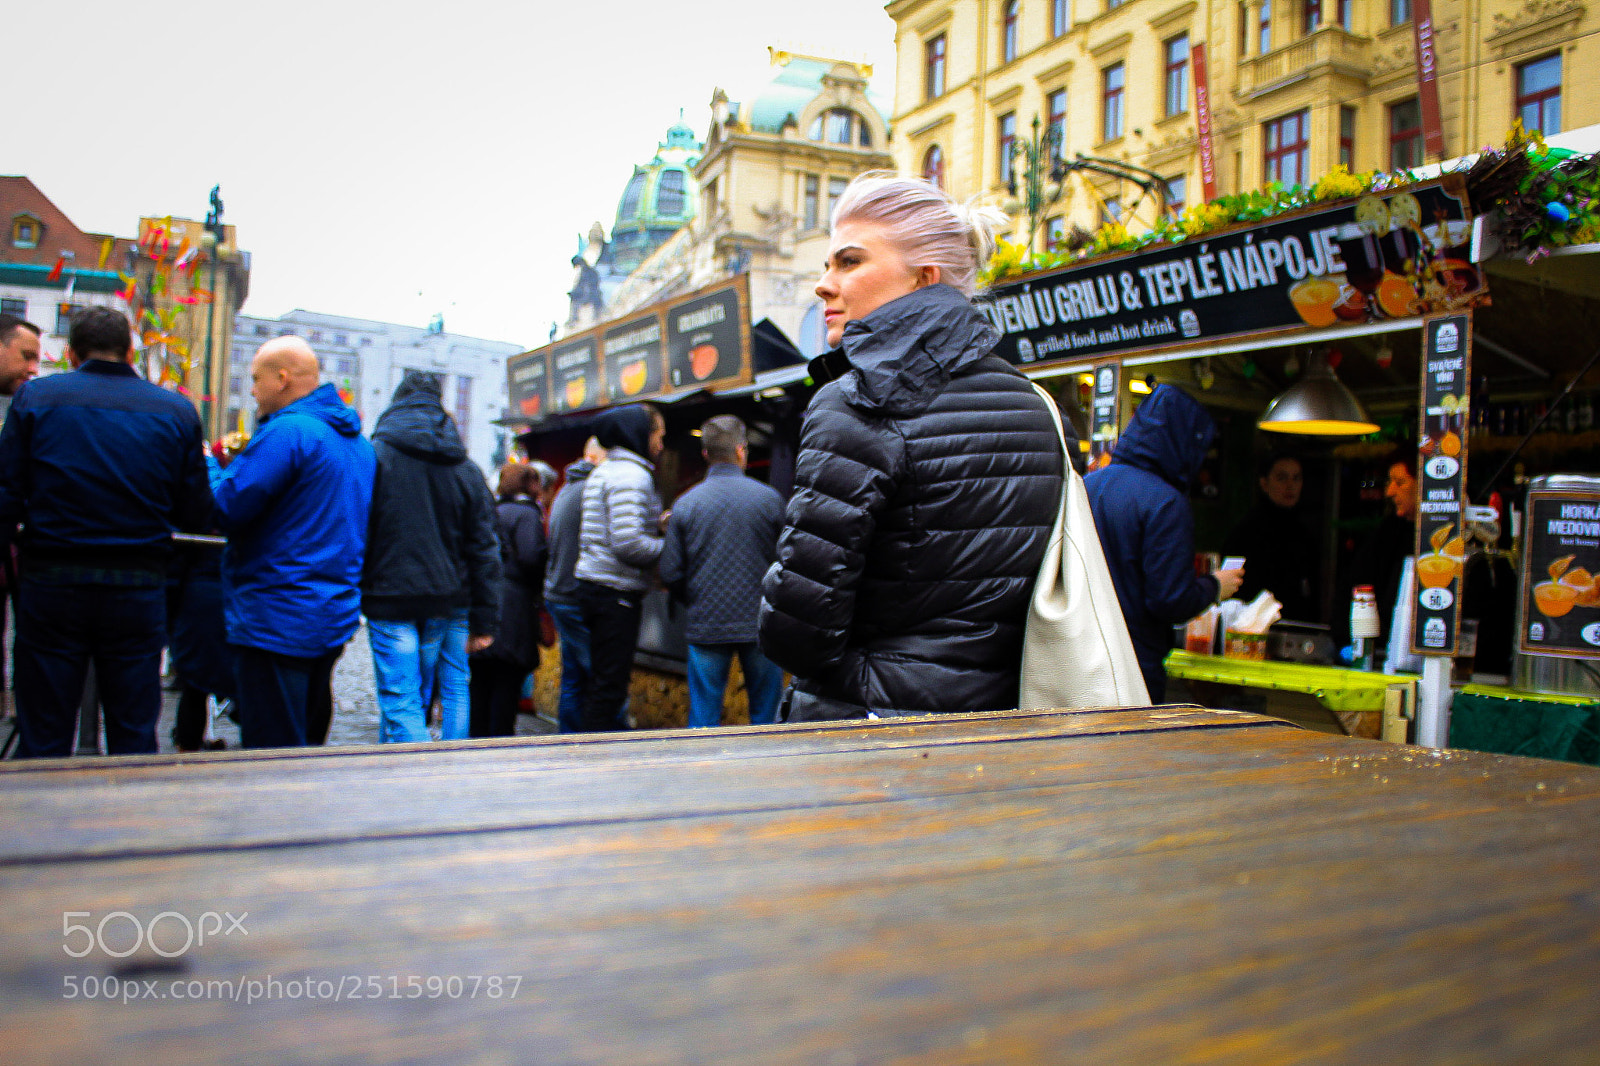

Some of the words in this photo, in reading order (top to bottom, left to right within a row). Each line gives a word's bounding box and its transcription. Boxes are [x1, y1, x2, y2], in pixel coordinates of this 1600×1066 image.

[1419, 18, 1435, 82] HOTEL
[1034, 287, 1056, 327] U
[1053, 273, 1120, 324] GRILU
[1119, 270, 1143, 311] &
[1139, 243, 1224, 307] TEPLÉ
[1218, 226, 1347, 293] NÁPOJE
[1035, 332, 1072, 358] grilled
[1070, 328, 1098, 349] food
[1098, 324, 1120, 345] and
[1119, 321, 1141, 341] hot
[1141, 315, 1177, 338] drink
